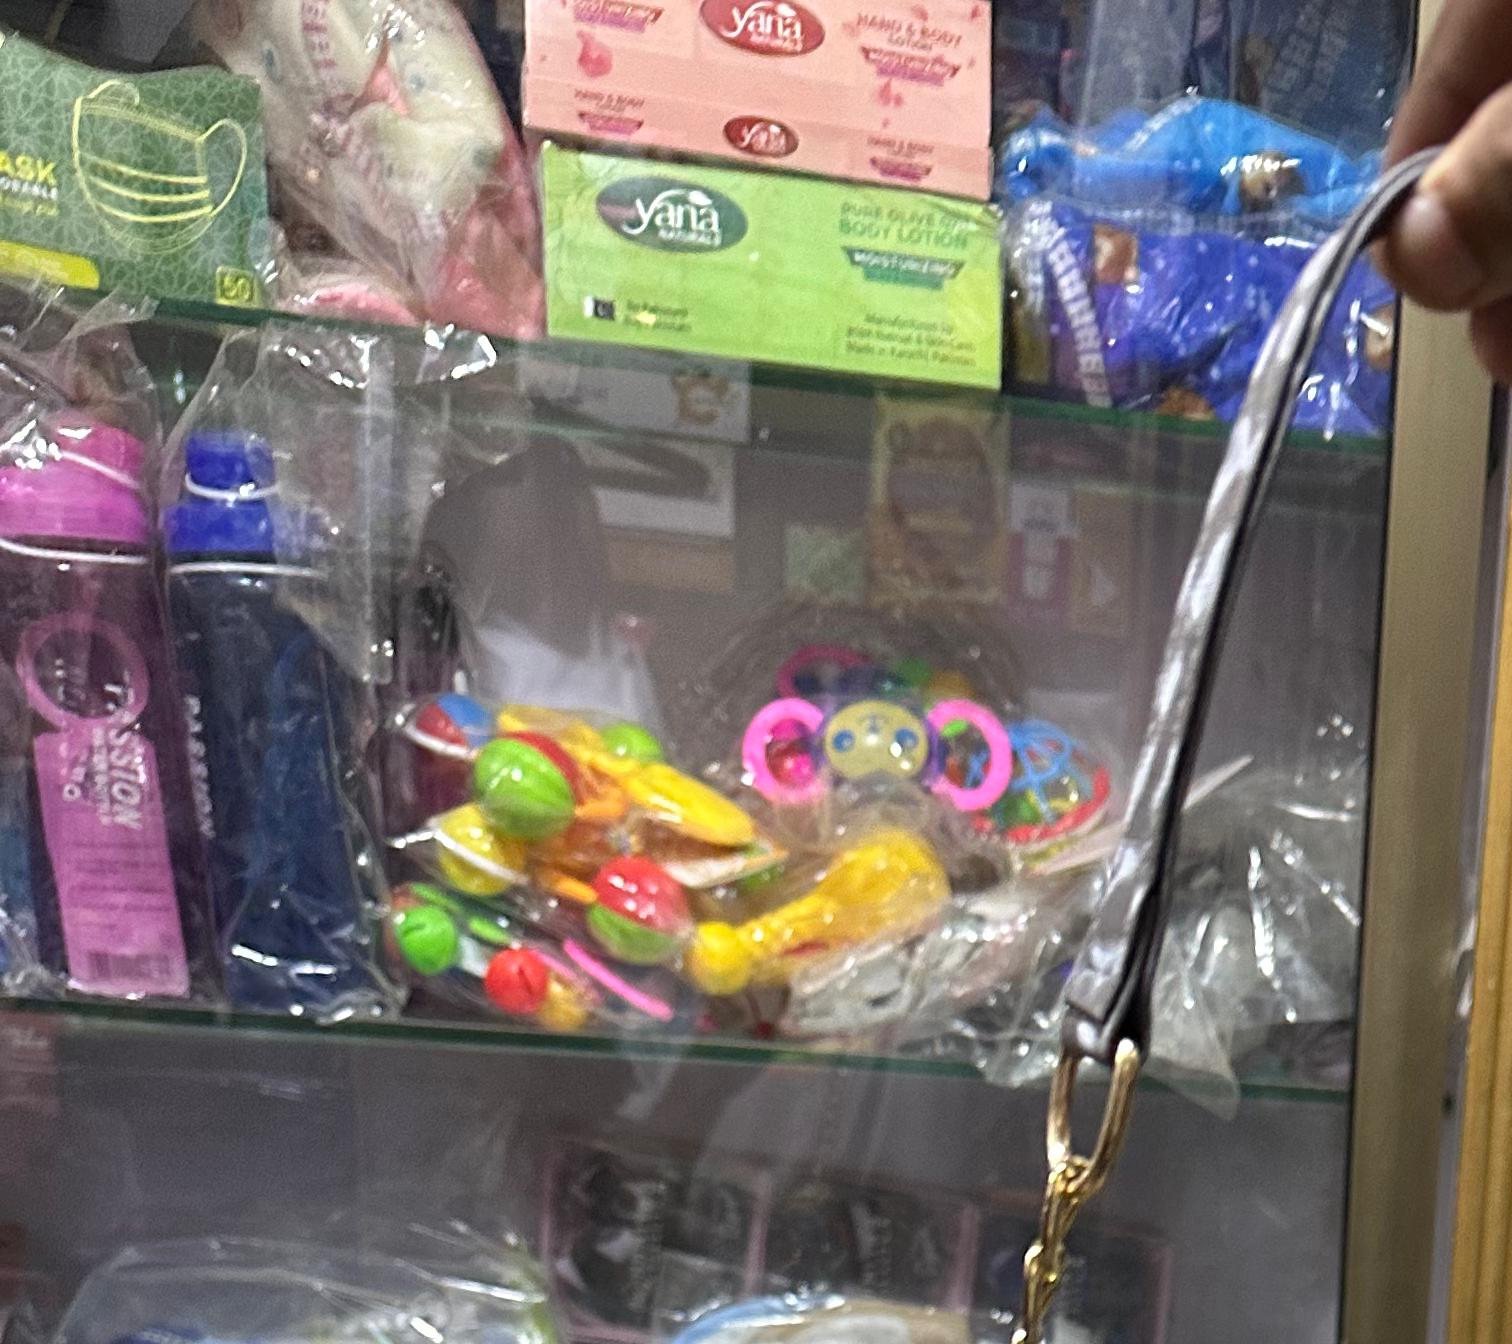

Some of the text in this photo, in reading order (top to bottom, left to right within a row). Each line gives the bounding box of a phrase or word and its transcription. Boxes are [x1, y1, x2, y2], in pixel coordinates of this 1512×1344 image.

[720, 1, 803, 40] yana
[621, 188, 720, 236] yana
[839, 218, 970, 250] BODY LOTION
